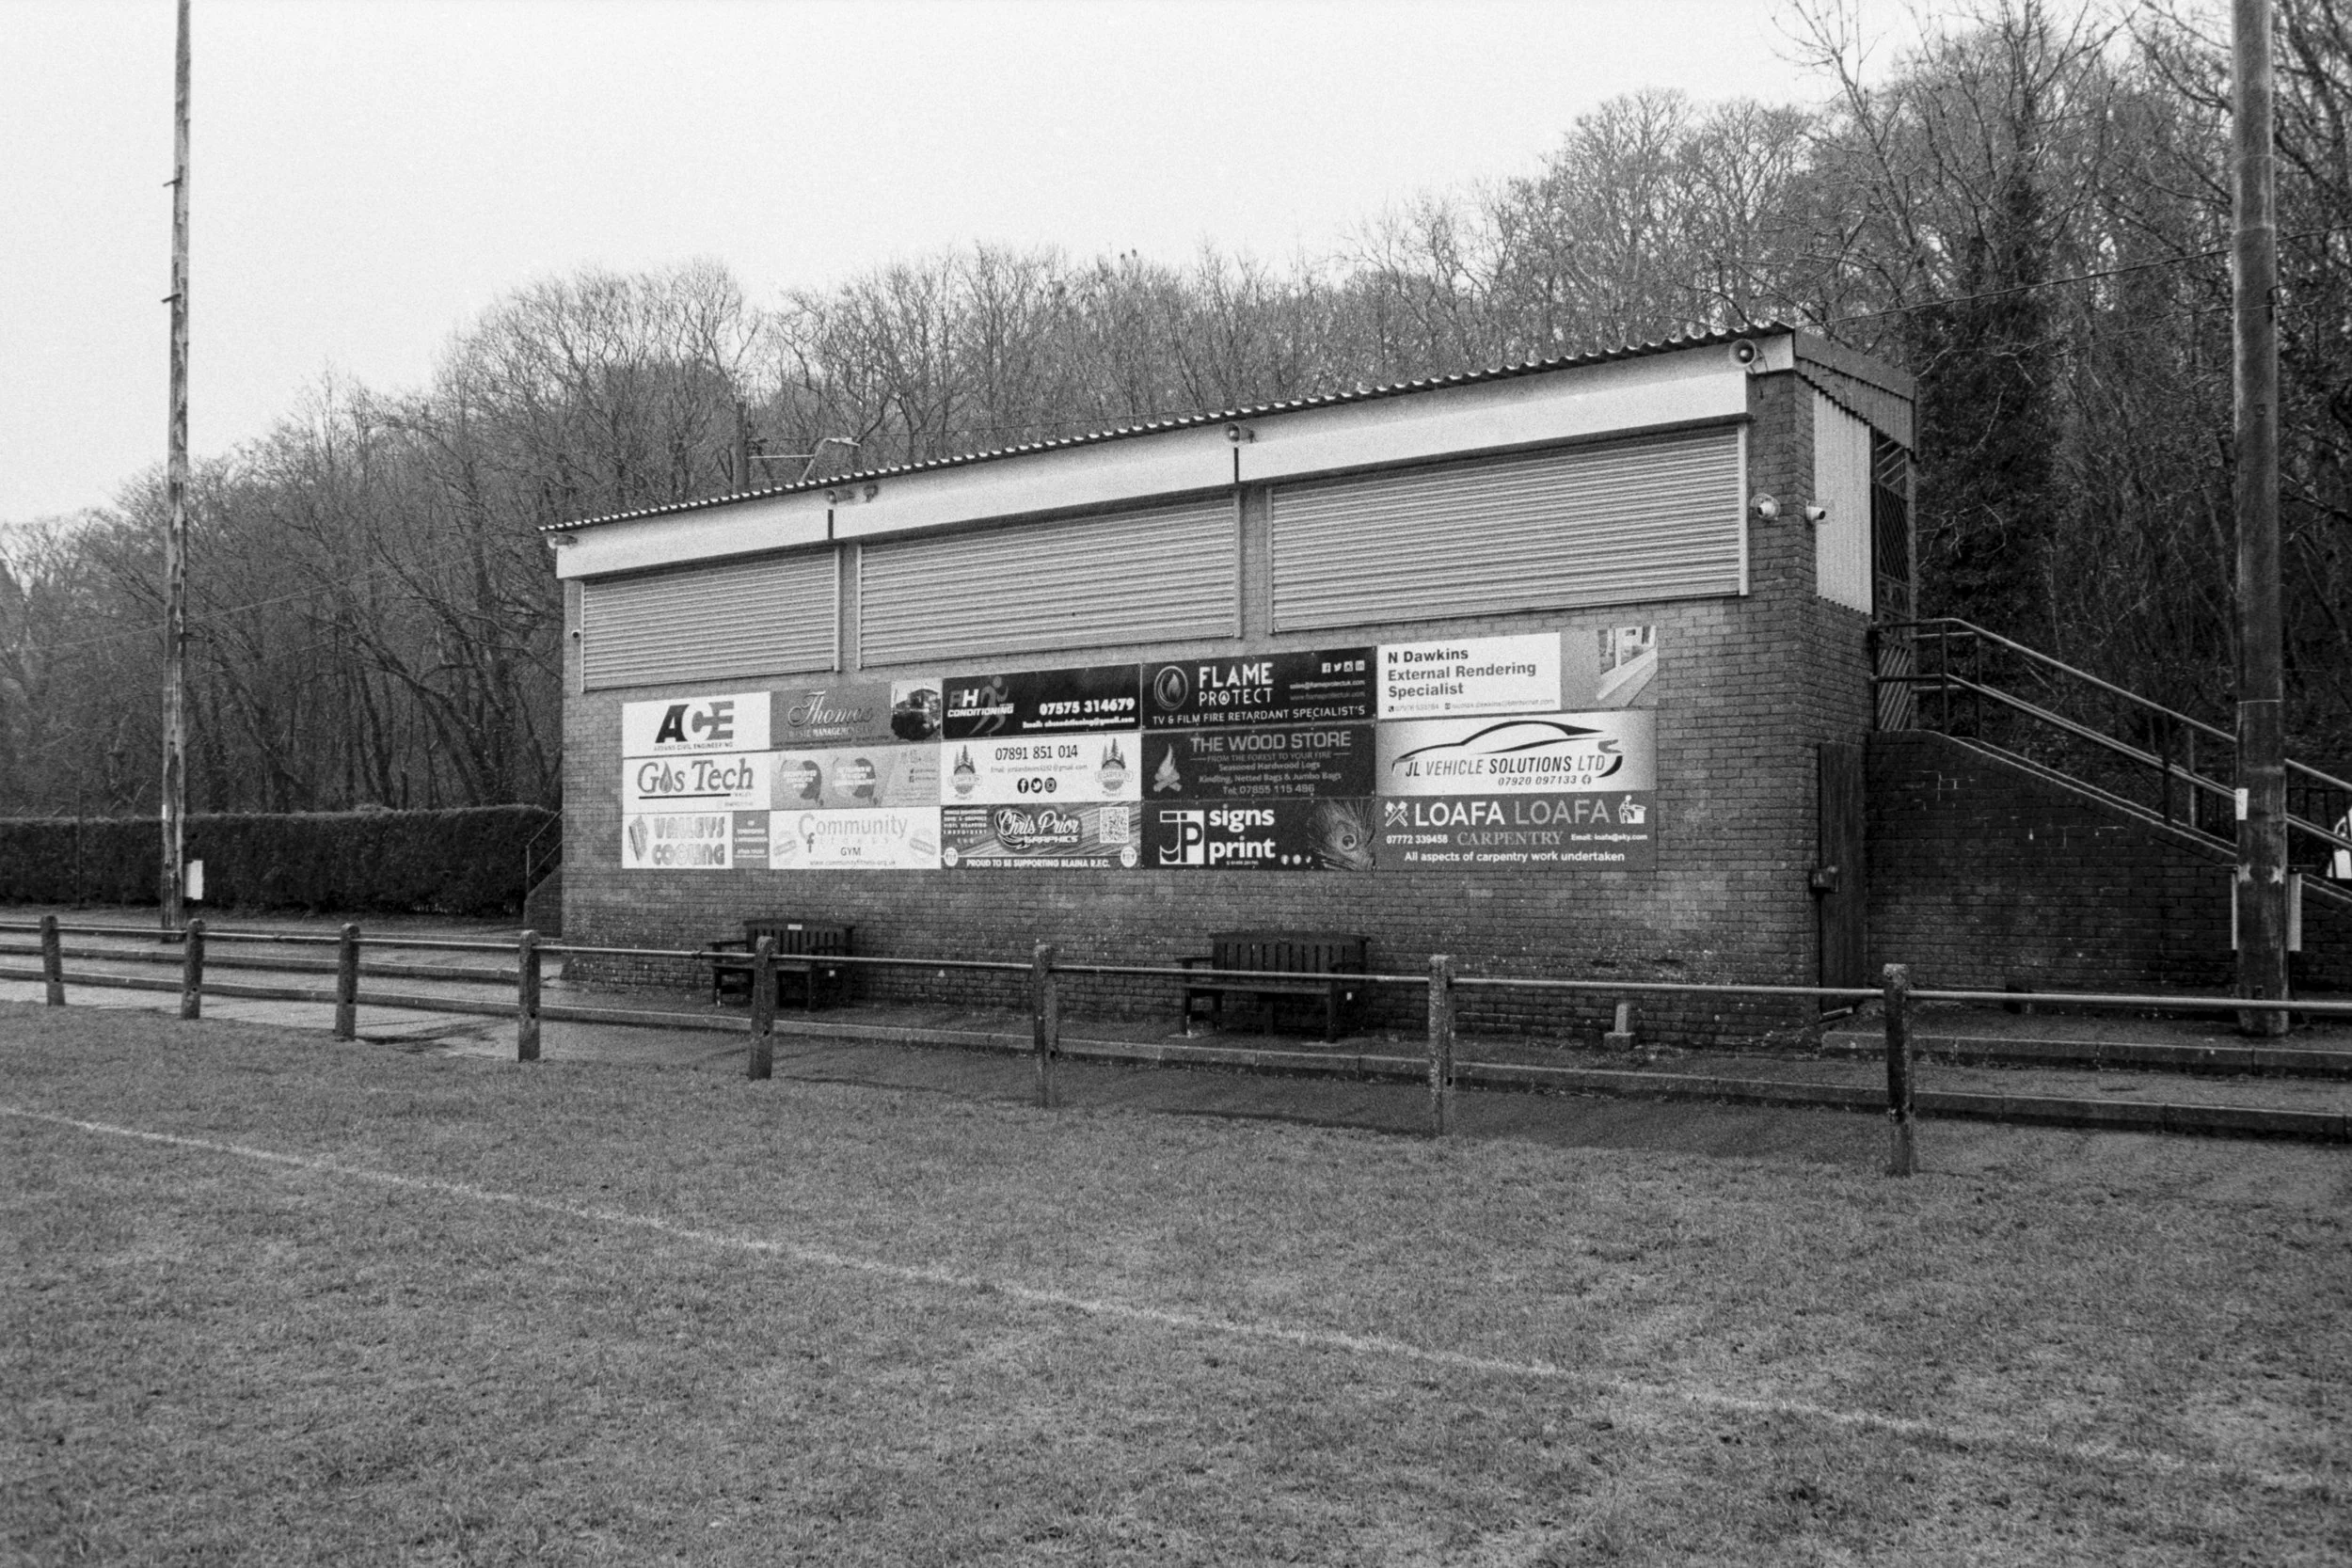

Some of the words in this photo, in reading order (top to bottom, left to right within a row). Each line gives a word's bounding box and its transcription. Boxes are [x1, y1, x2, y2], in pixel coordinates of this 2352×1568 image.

[1388, 651, 1398, 664] N
[1404, 648, 1469, 663] Dawkins
[1199, 662, 1274, 689] FLAME
[1388, 666, 1450, 681] External
[1455, 661, 1536, 677] Rendering
[1199, 688, 1274, 706] PROTECT
[1389, 682, 1464, 700] Specialist
[787, 690, 873, 727] Thomas
[947, 706, 1014, 718] CONDITIONING
[1039, 701, 1080, 716] 07575
[1084, 697, 1135, 713] 314679
[1152, 716, 1166, 725] TV
[1168, 715, 1174, 724] &
[1177, 714, 1200, 723] FILM
[1203, 712, 1225, 722] FIRE
[1228, 709, 1289, 721] RETARDANT
[1293, 705, 1365, 719] SPECIALIST'S
[655, 701, 734, 743] ACE
[693, 741, 733, 750] ENGINEERING
[1190, 736, 1224, 752] THE
[1228, 734, 1285, 751] WOOD
[1291, 731, 1351, 749] STORE
[995, 747, 1028, 760] 07891
[1033, 746, 1053, 759] 851
[1058, 745, 1078, 758] 014
[1291, 752, 1312, 760] YOUR
[1314, 751, 1332, 759] FIRE
[691, 757, 753, 791] Tech
[1219, 763, 1256, 771] Seasoned
[1257, 761, 1299, 770] Hardwood
[1301, 761, 1321, 770] Logs
[1406, 761, 1420, 777] JL
[1425, 759, 1484, 776] VEHICLE
[1488, 755, 1573, 774] SOLUTIONS
[1578, 754, 1606, 771] LTD
[1234, 773, 1262, 782] Netted
[1263, 772, 1282, 783] Bags
[1284, 772, 1291, 781] &
[1292, 772, 1320, 781] Jumbo
[1322, 771, 1342, 782] Bags
[1498, 776, 1532, 786] 07920
[1535, 775, 1578, 785] 097133
[1274, 784, 1293, 793] 115
[1209, 803, 1275, 832] signs
[1415, 800, 1506, 827] LOAFA
[1515, 799, 1611, 825] LOAFA
[654, 816, 724, 839] VALLEYS
[799, 813, 908, 839] Community
[1000, 809, 1036, 836] Chris
[1038, 810, 1080, 835] Prior
[1024, 835, 1079, 844] GRAPHICS
[1386, 834, 1413, 845] 07772
[1415, 833, 1448, 844] 339458
[1457, 831, 1564, 846] CARPENTRY
[840, 847, 862, 857] GYM
[1209, 835, 1277, 865] print
[1405, 851, 1419, 862] All
[1421, 852, 1460, 863] aspects
[1463, 851, 1474, 862] of
[1476, 851, 1528, 863] carpentry
[1531, 850, 1558, 861] work
[1561, 851, 1625, 862] undertaken
[966, 859, 992, 867] PROUD
[993, 859, 1002, 867] TO
[1003, 859, 1012, 867] BE
[1013, 859, 1059, 867] SUPPORTING
[1090, 859, 1111, 867] R.F.C.
